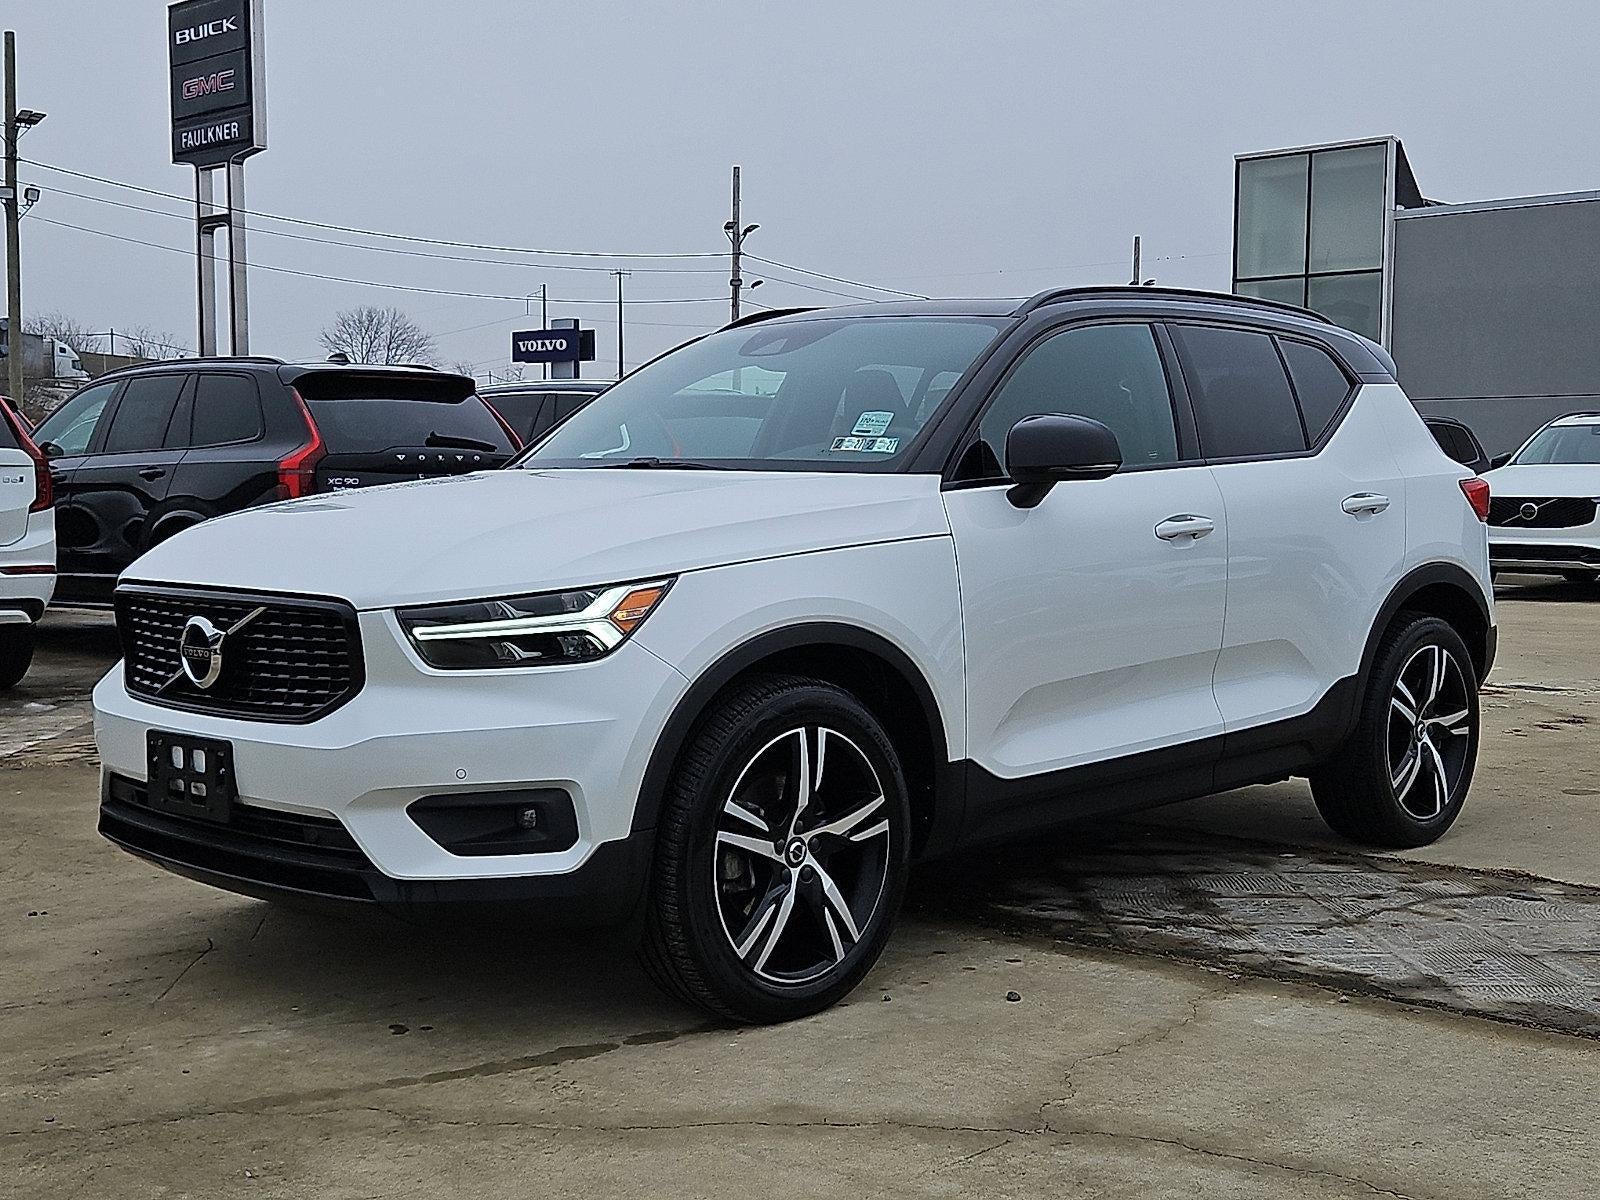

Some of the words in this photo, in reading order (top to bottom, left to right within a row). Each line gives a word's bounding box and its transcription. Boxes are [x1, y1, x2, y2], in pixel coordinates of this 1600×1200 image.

[175, 15, 238, 45] BUICK
[182, 69, 235, 100] GMC
[181, 121, 239, 149] FAULKNER
[517, 338, 567, 352] VOLVO
[396, 454, 481, 462] VOLVO
[183, 648, 210, 658] VOLVO
